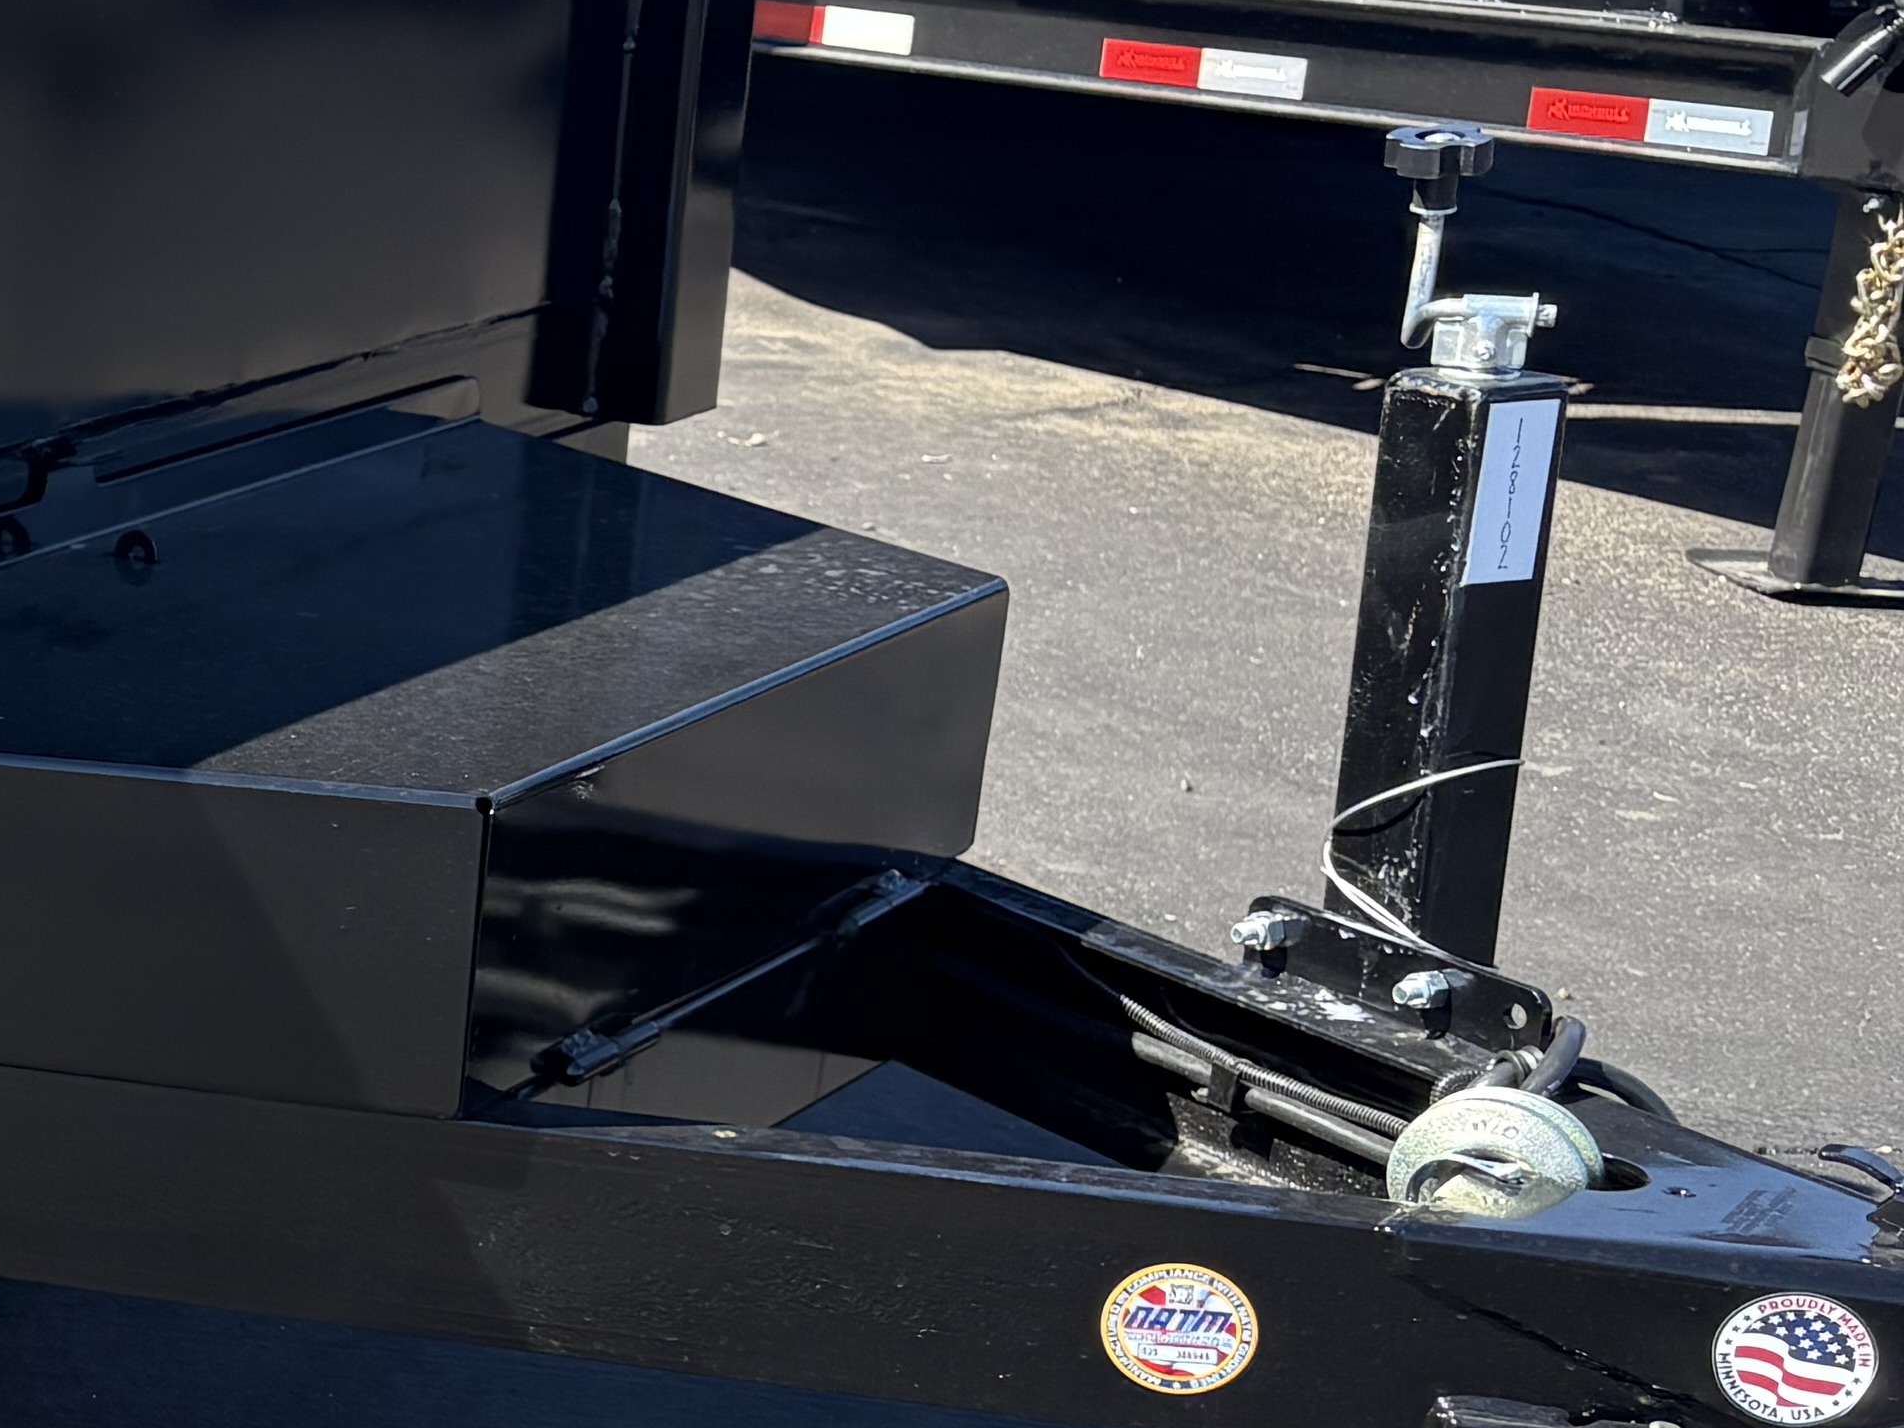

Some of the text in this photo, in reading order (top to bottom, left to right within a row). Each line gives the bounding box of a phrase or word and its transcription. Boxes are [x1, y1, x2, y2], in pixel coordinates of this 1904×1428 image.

[1757, 1298, 1873, 1367] PROUDLY MADE IN
[1791, 1406, 1825, 1421] USA
